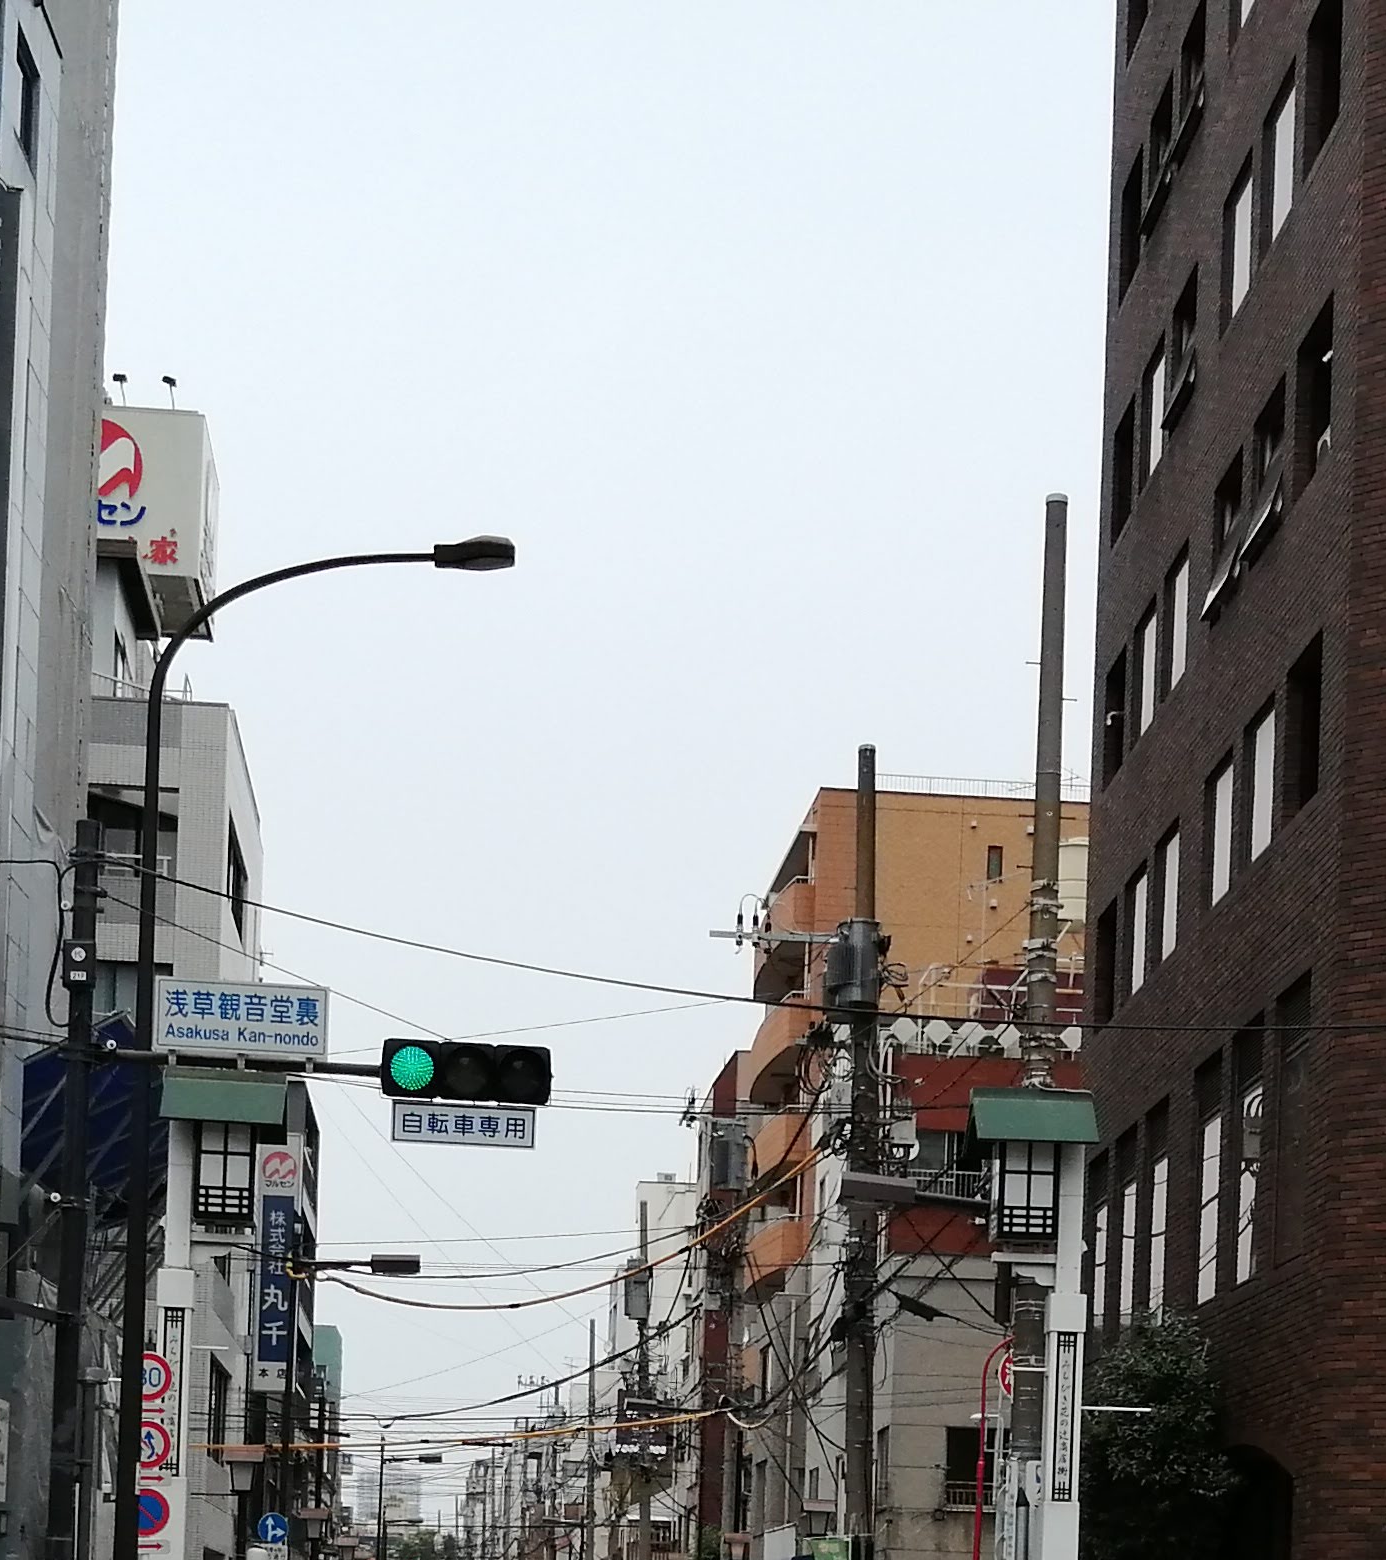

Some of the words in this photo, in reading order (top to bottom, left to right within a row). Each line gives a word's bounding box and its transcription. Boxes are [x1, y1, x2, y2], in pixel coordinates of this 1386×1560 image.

[164, 988, 321, 1027] 浅草観音堂裏
[164, 1024, 229, 1043] Asakusa
[236, 1026, 319, 1048] Kan-nondo
[401, 1110, 527, 1141] 自転車専用
[265, 1179, 295, 1189] マルセン
